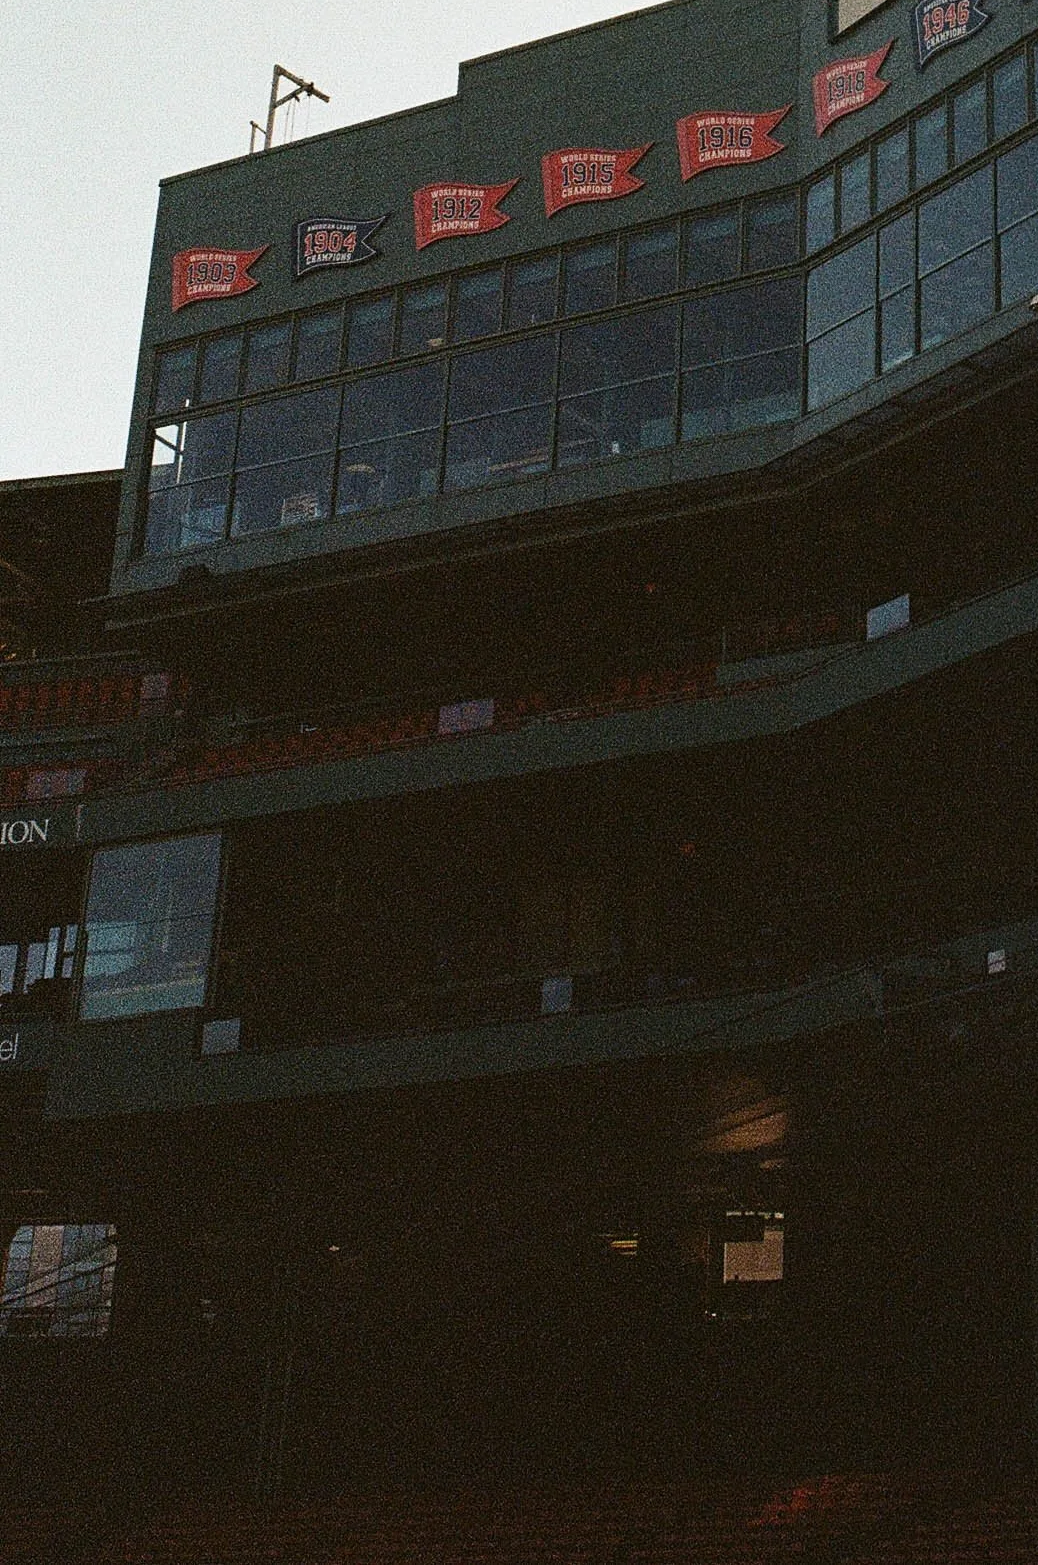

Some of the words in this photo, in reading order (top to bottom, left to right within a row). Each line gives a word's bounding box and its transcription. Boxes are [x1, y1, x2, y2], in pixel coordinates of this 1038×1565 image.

[922, 0, 970, 41] 1946
[926, 25, 967, 50] CHAMPIONS
[828, 70, 866, 103] 1918
[696, 117, 725, 127] WORLD
[727, 117, 755, 125] SERIES
[698, 125, 753, 151] 1916
[560, 154, 588, 163] WORLD
[589, 154, 616, 162] SERIES
[698, 148, 752, 162] CHAMPIONS
[562, 162, 615, 187] 1915
[561, 185, 613, 198] CHAMPIONS
[432, 197, 483, 222] 1912
[431, 220, 480, 233] CHAMPIONS
[304, 230, 358, 257] 1904
[305, 253, 352, 265] CHAMPIONS
[187, 261, 238, 286] 1903
[187, 284, 231, 295] CHAMPIONS
